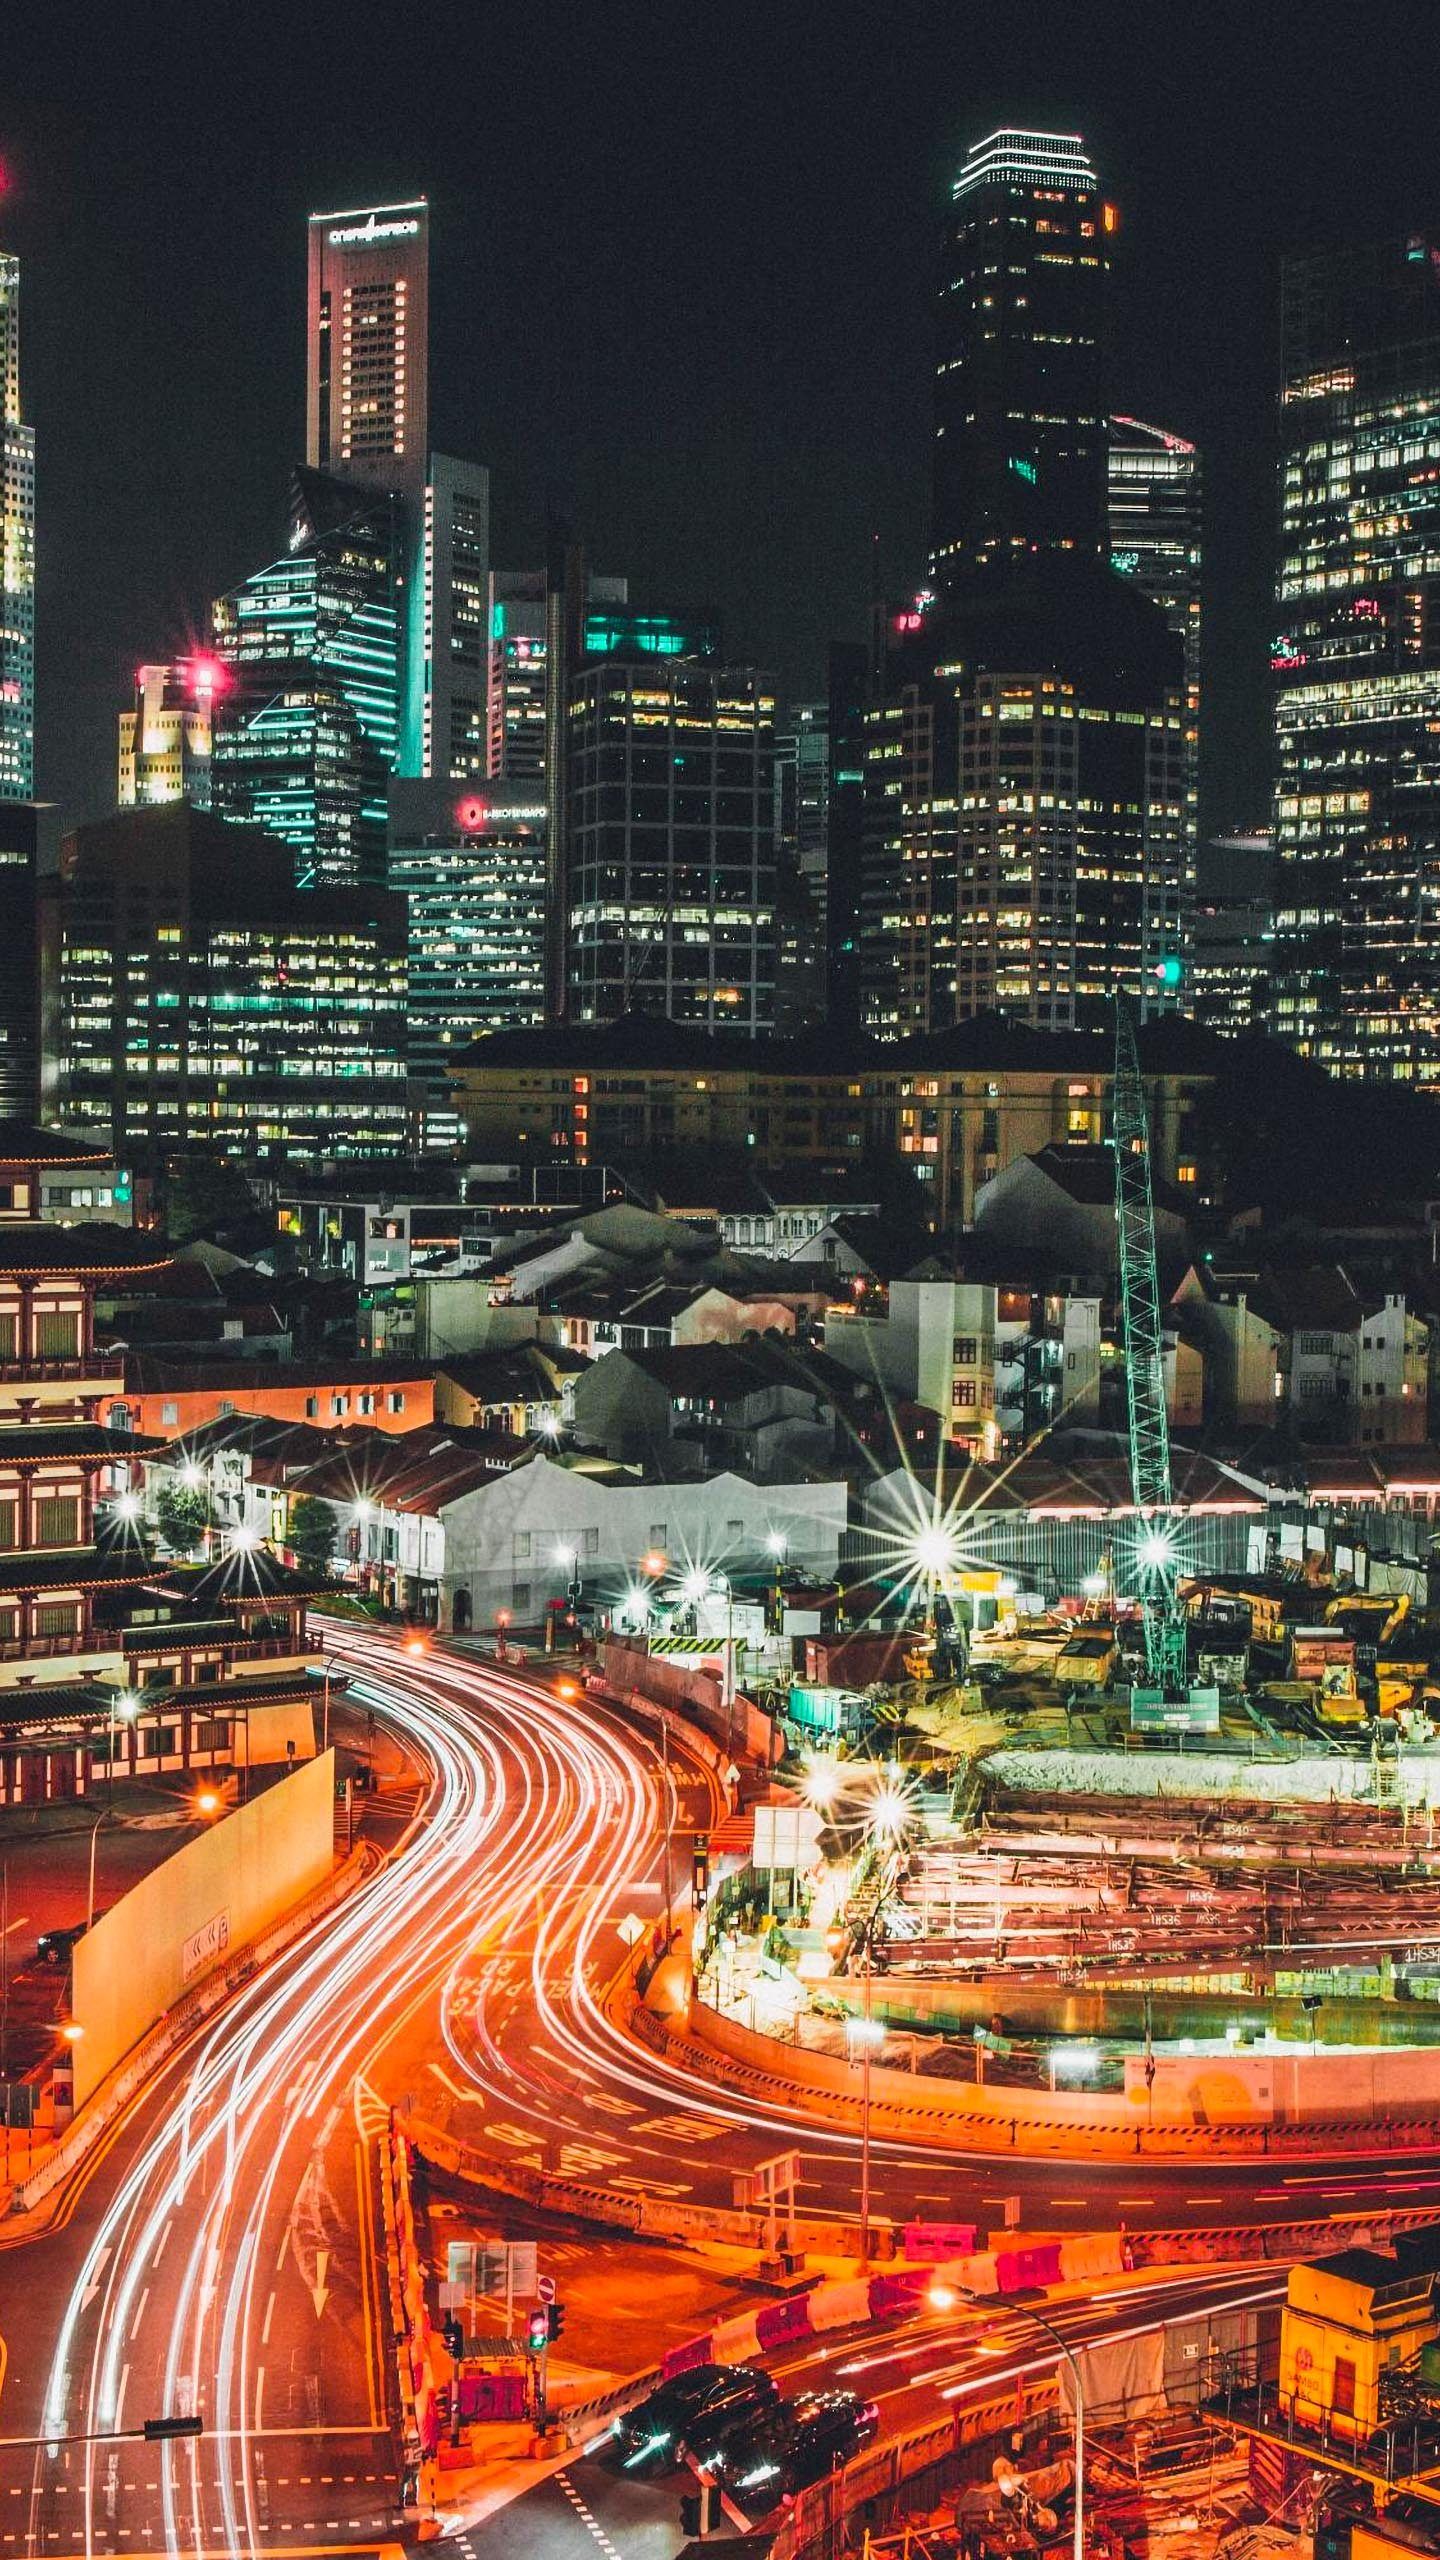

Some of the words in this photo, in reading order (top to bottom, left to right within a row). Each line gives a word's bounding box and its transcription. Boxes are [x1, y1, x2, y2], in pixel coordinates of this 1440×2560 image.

[1151, 1914, 1181, 1925] 1HS36
[480, 1958, 517, 1976] RD
[483, 2122, 548, 2147] RD
[510, 2143, 632, 2177] PAGAR
[608, 2175, 694, 2196] TG
